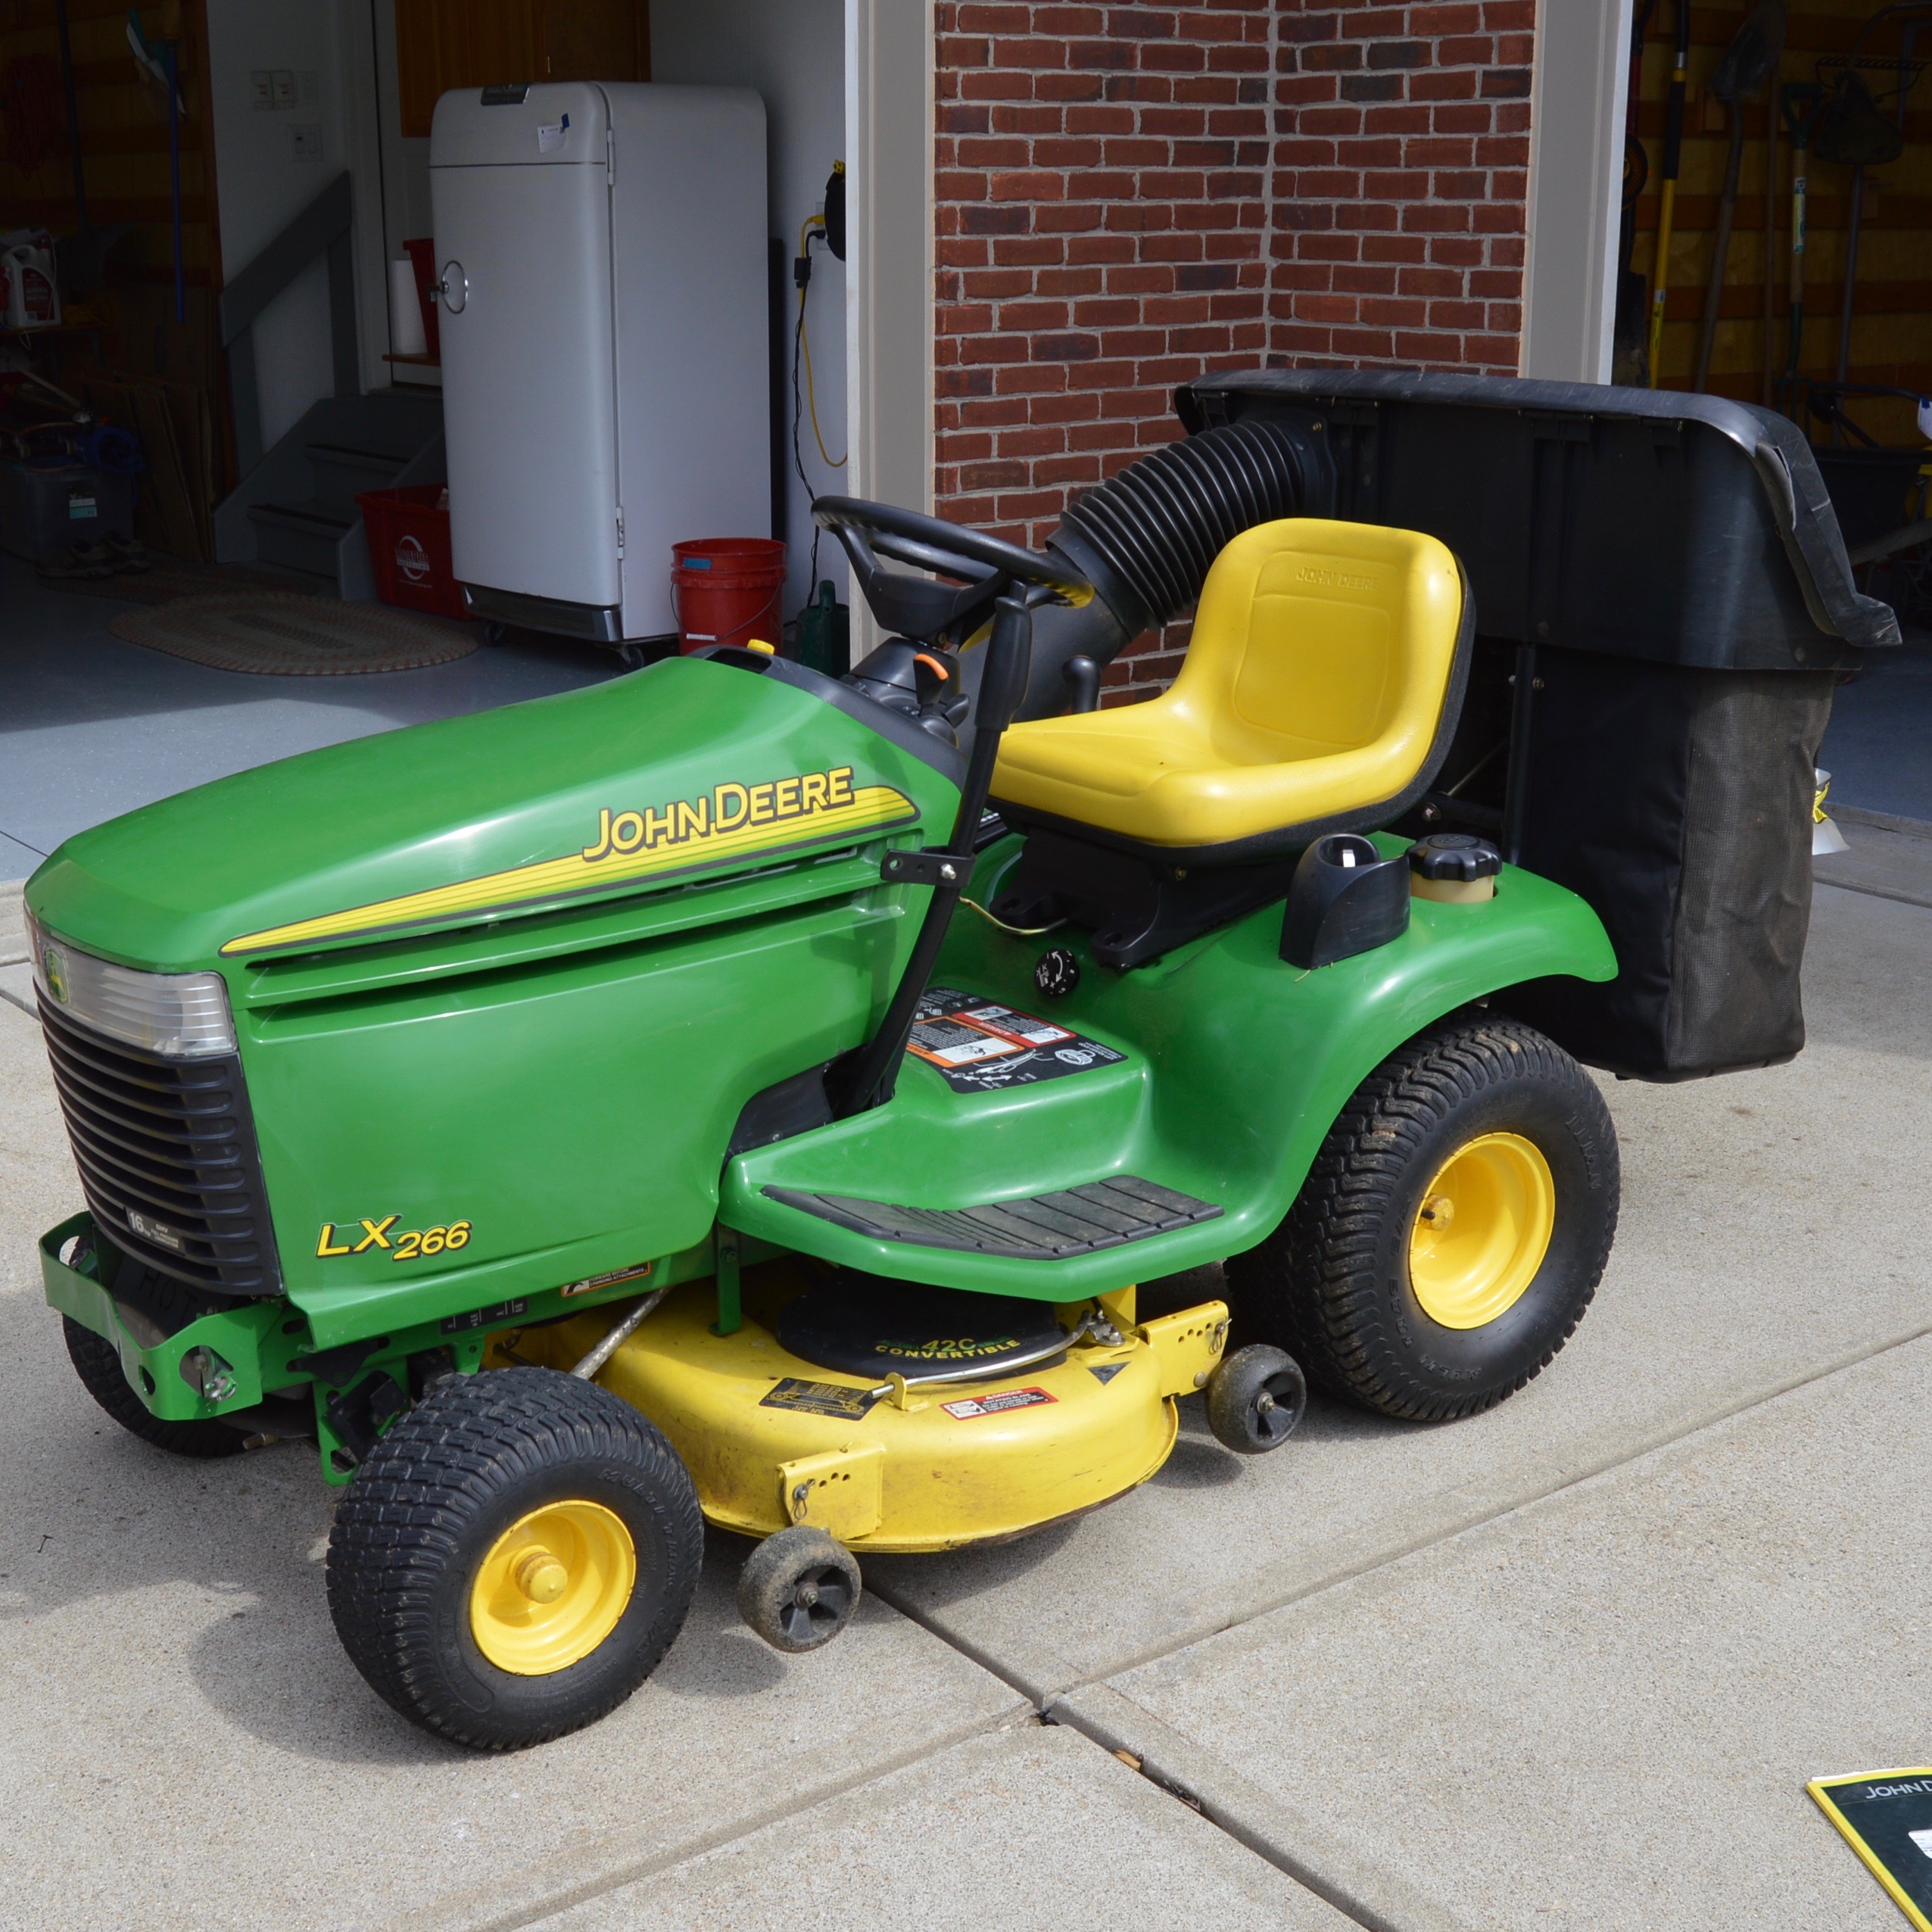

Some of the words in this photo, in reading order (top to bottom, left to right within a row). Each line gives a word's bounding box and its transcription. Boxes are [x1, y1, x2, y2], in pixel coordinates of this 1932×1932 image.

[1295, 567, 1335, 585] JOHN
[1337, 574, 1379, 591] DEERE
[582, 796, 715, 862] JOHN
[712, 766, 855, 834] DEERE
[129, 1211, 145, 1233] 16
[874, 1338, 1021, 1359] CONVERTIBLE
[921, 1338, 977, 1352] 42C
[1865, 1782, 1924, 1800] JOHN
